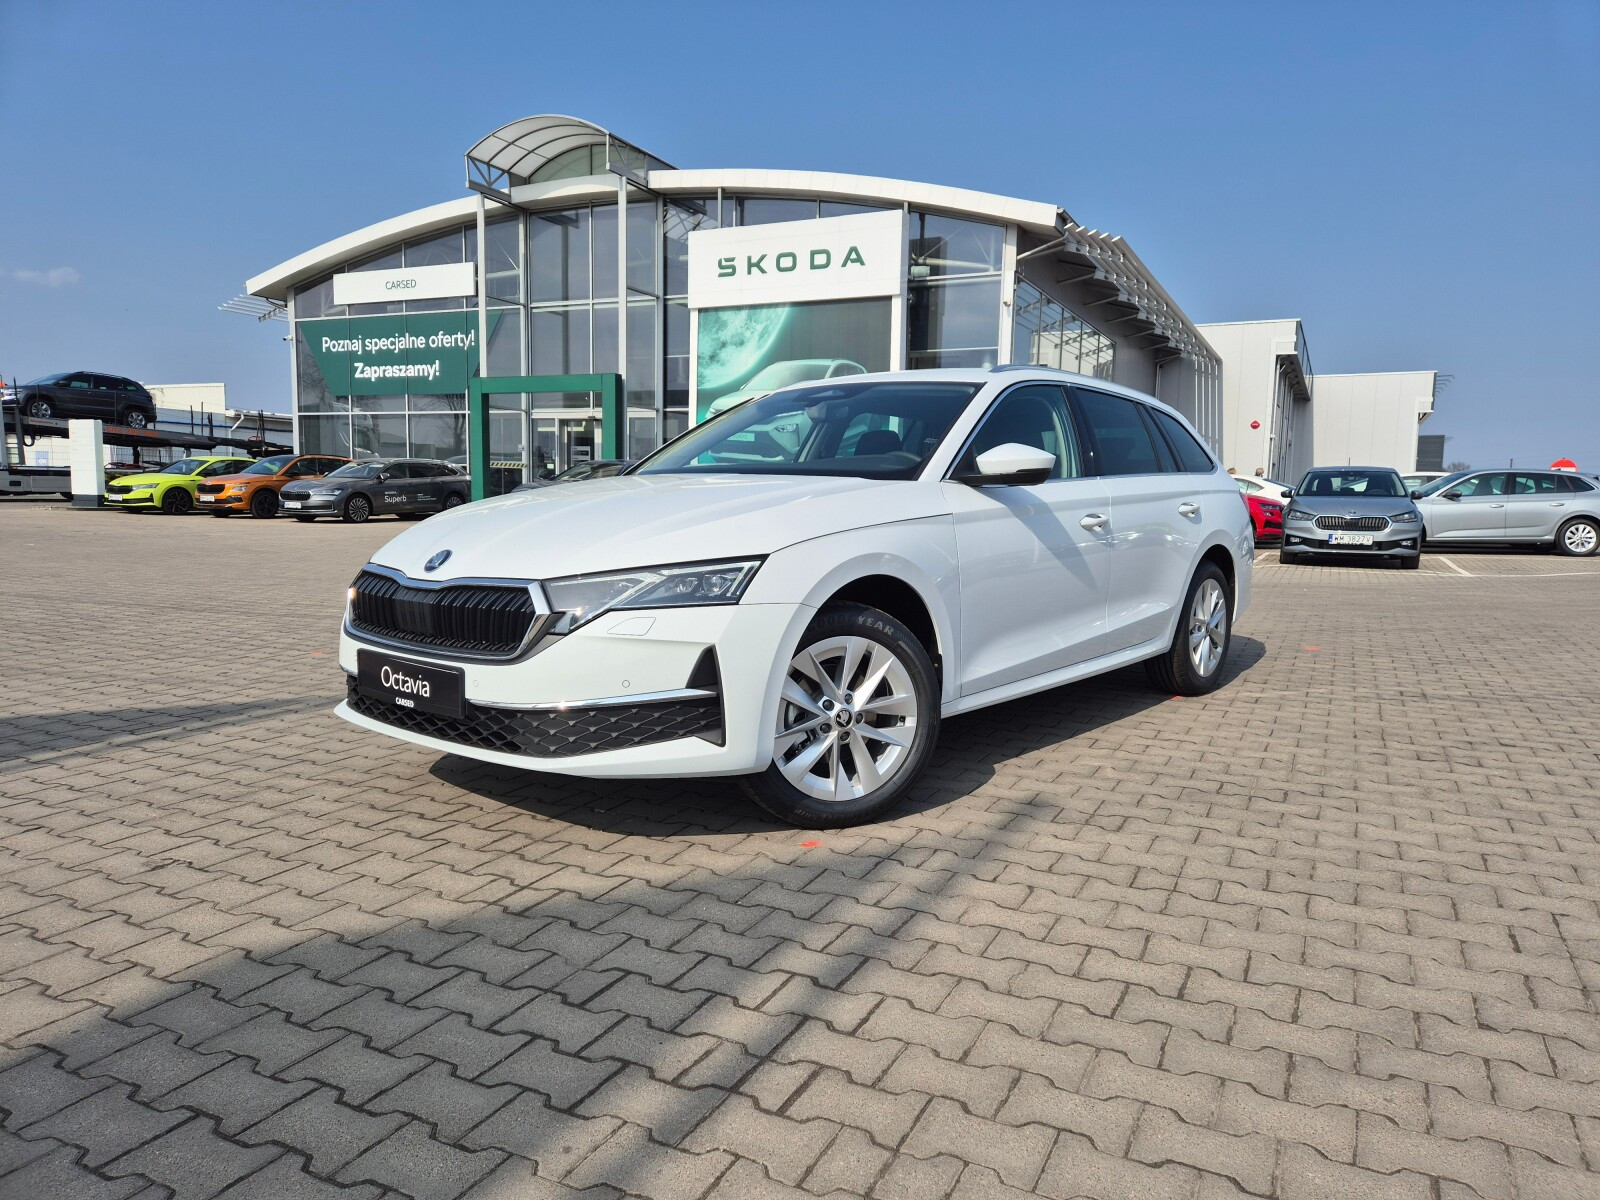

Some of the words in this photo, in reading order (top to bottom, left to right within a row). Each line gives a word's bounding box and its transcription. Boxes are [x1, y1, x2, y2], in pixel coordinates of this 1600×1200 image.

[385, 279, 417, 290] CARSED
[321, 335, 362, 355] Poznaj
[364, 332, 426, 355] specjalne
[428, 329, 475, 351] oferty!
[353, 359, 441, 382] Zapraszamy!
[384, 494, 407, 505] Superb
[381, 666, 430, 697] Octavia
[395, 697, 414, 708] CARSED
